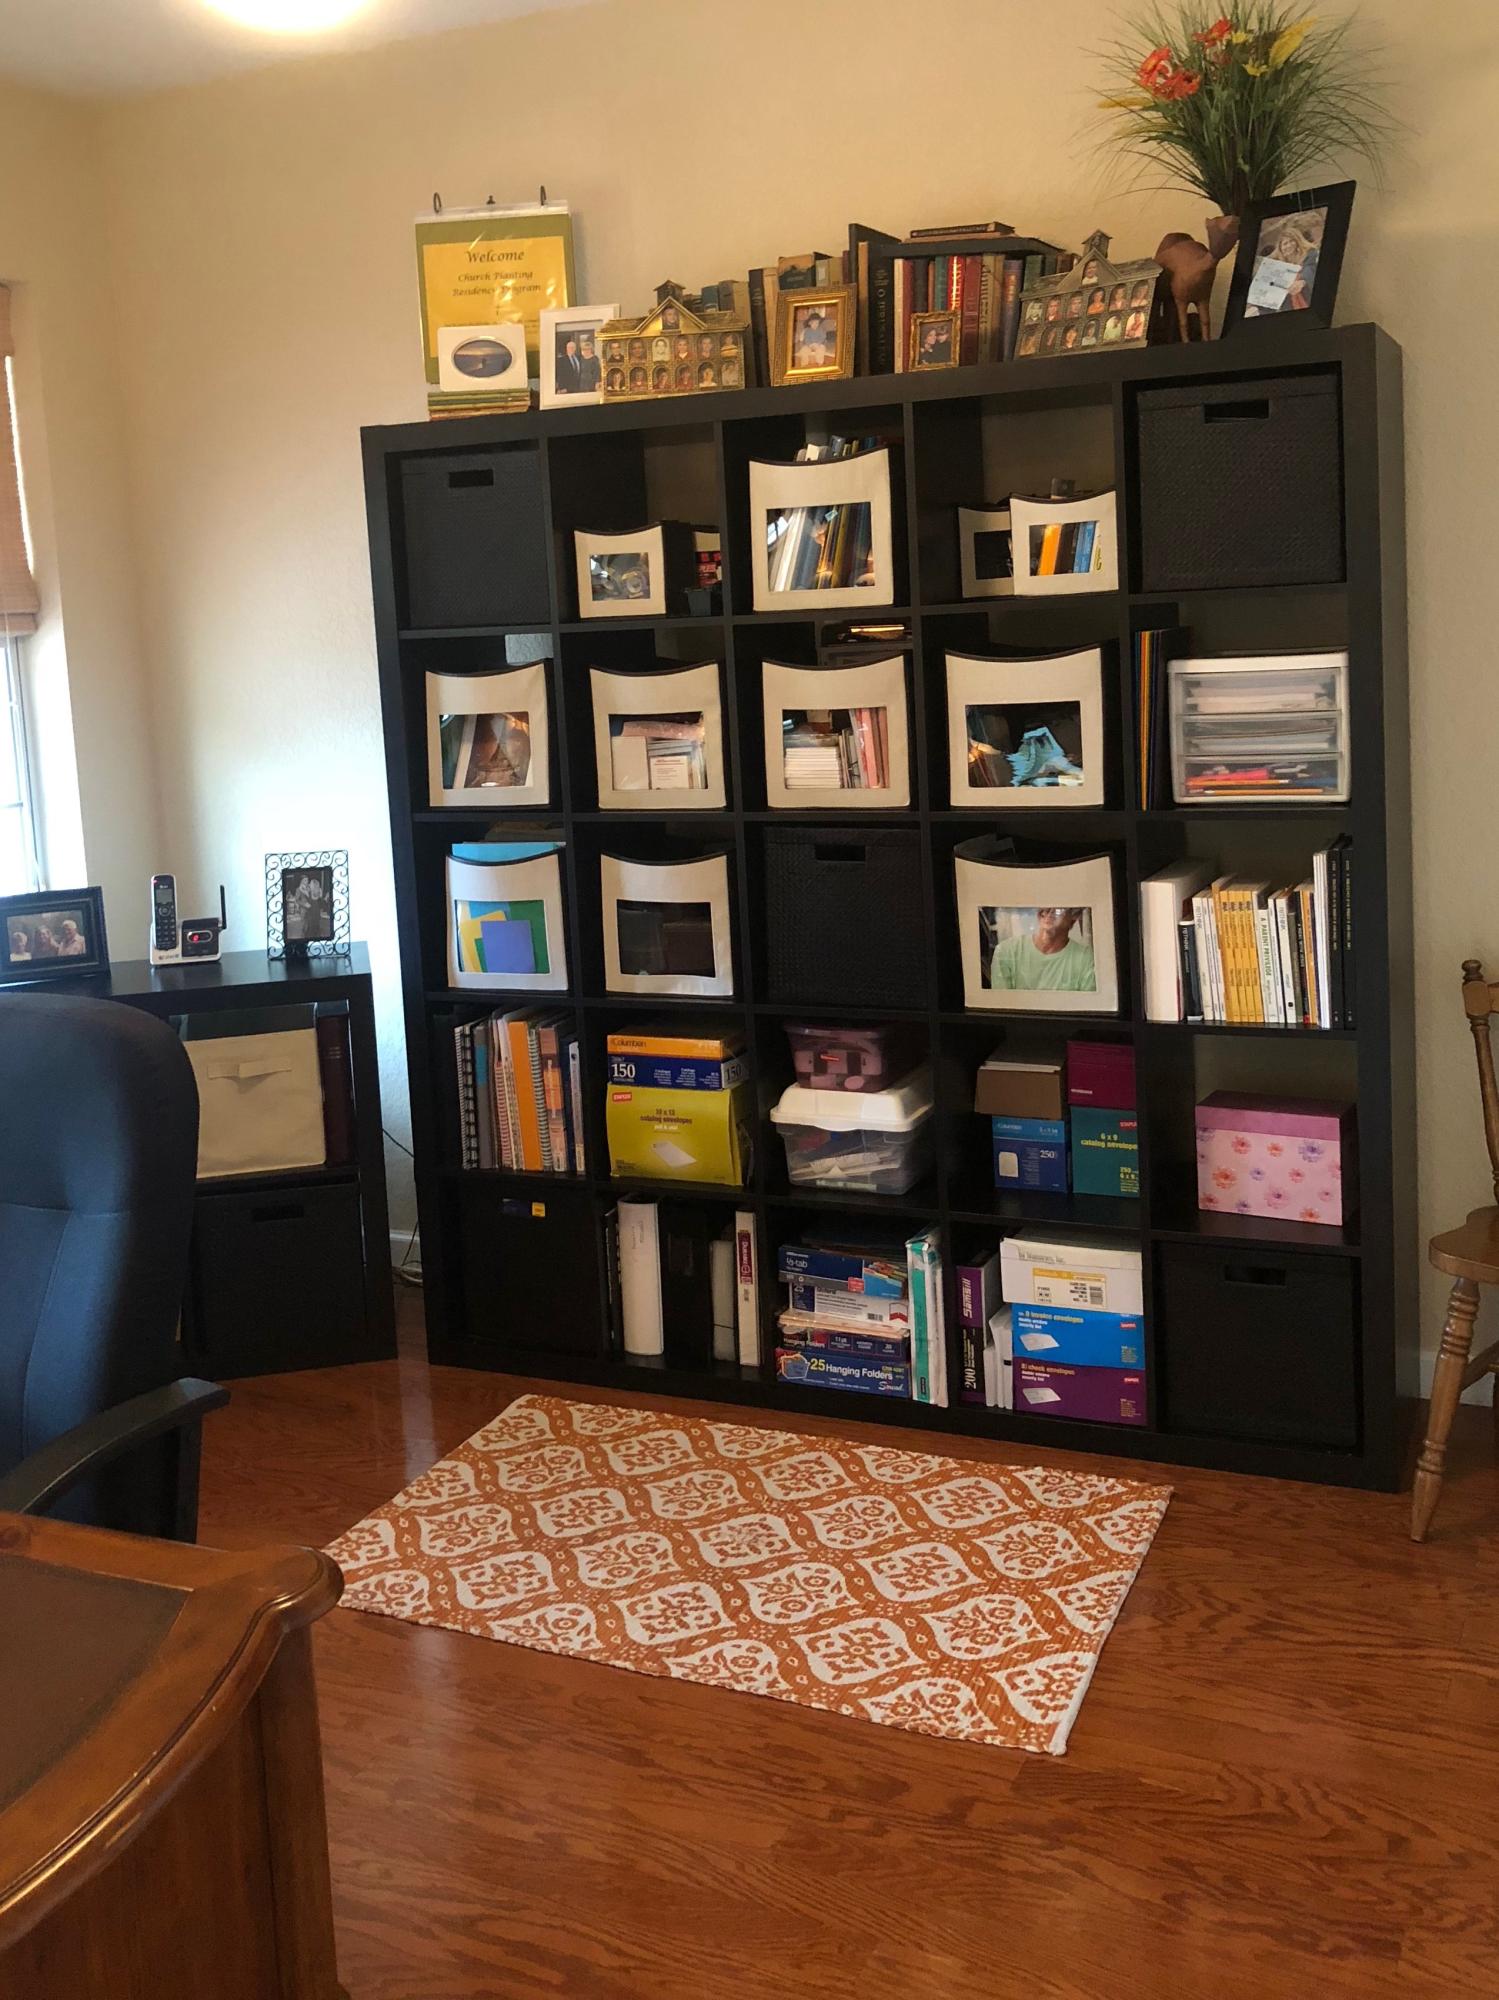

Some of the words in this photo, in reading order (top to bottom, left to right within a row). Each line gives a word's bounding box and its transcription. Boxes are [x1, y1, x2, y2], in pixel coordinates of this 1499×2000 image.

[465, 249, 525, 263] Welcome
[457, 271, 491, 282] Church
[493, 271, 533, 281] Planting
[1261, 924, 1270, 948] PARENT
[1263, 947, 1273, 976] PRIVILEGE
[611, 1063, 636, 1079] 150
[724, 1064, 742, 1082] 150
[1080, 1139, 1105, 1149] catalog
[1113, 1133, 1118, 1141] 9
[1039, 1150, 1054, 1159] 250
[1054, 1314, 1084, 1324] envelopes
[810, 1358, 826, 1371] 25
[826, 1364, 860, 1378] Hanging
[862, 1368, 894, 1381] Folders
[963, 1368, 977, 1390] 200
